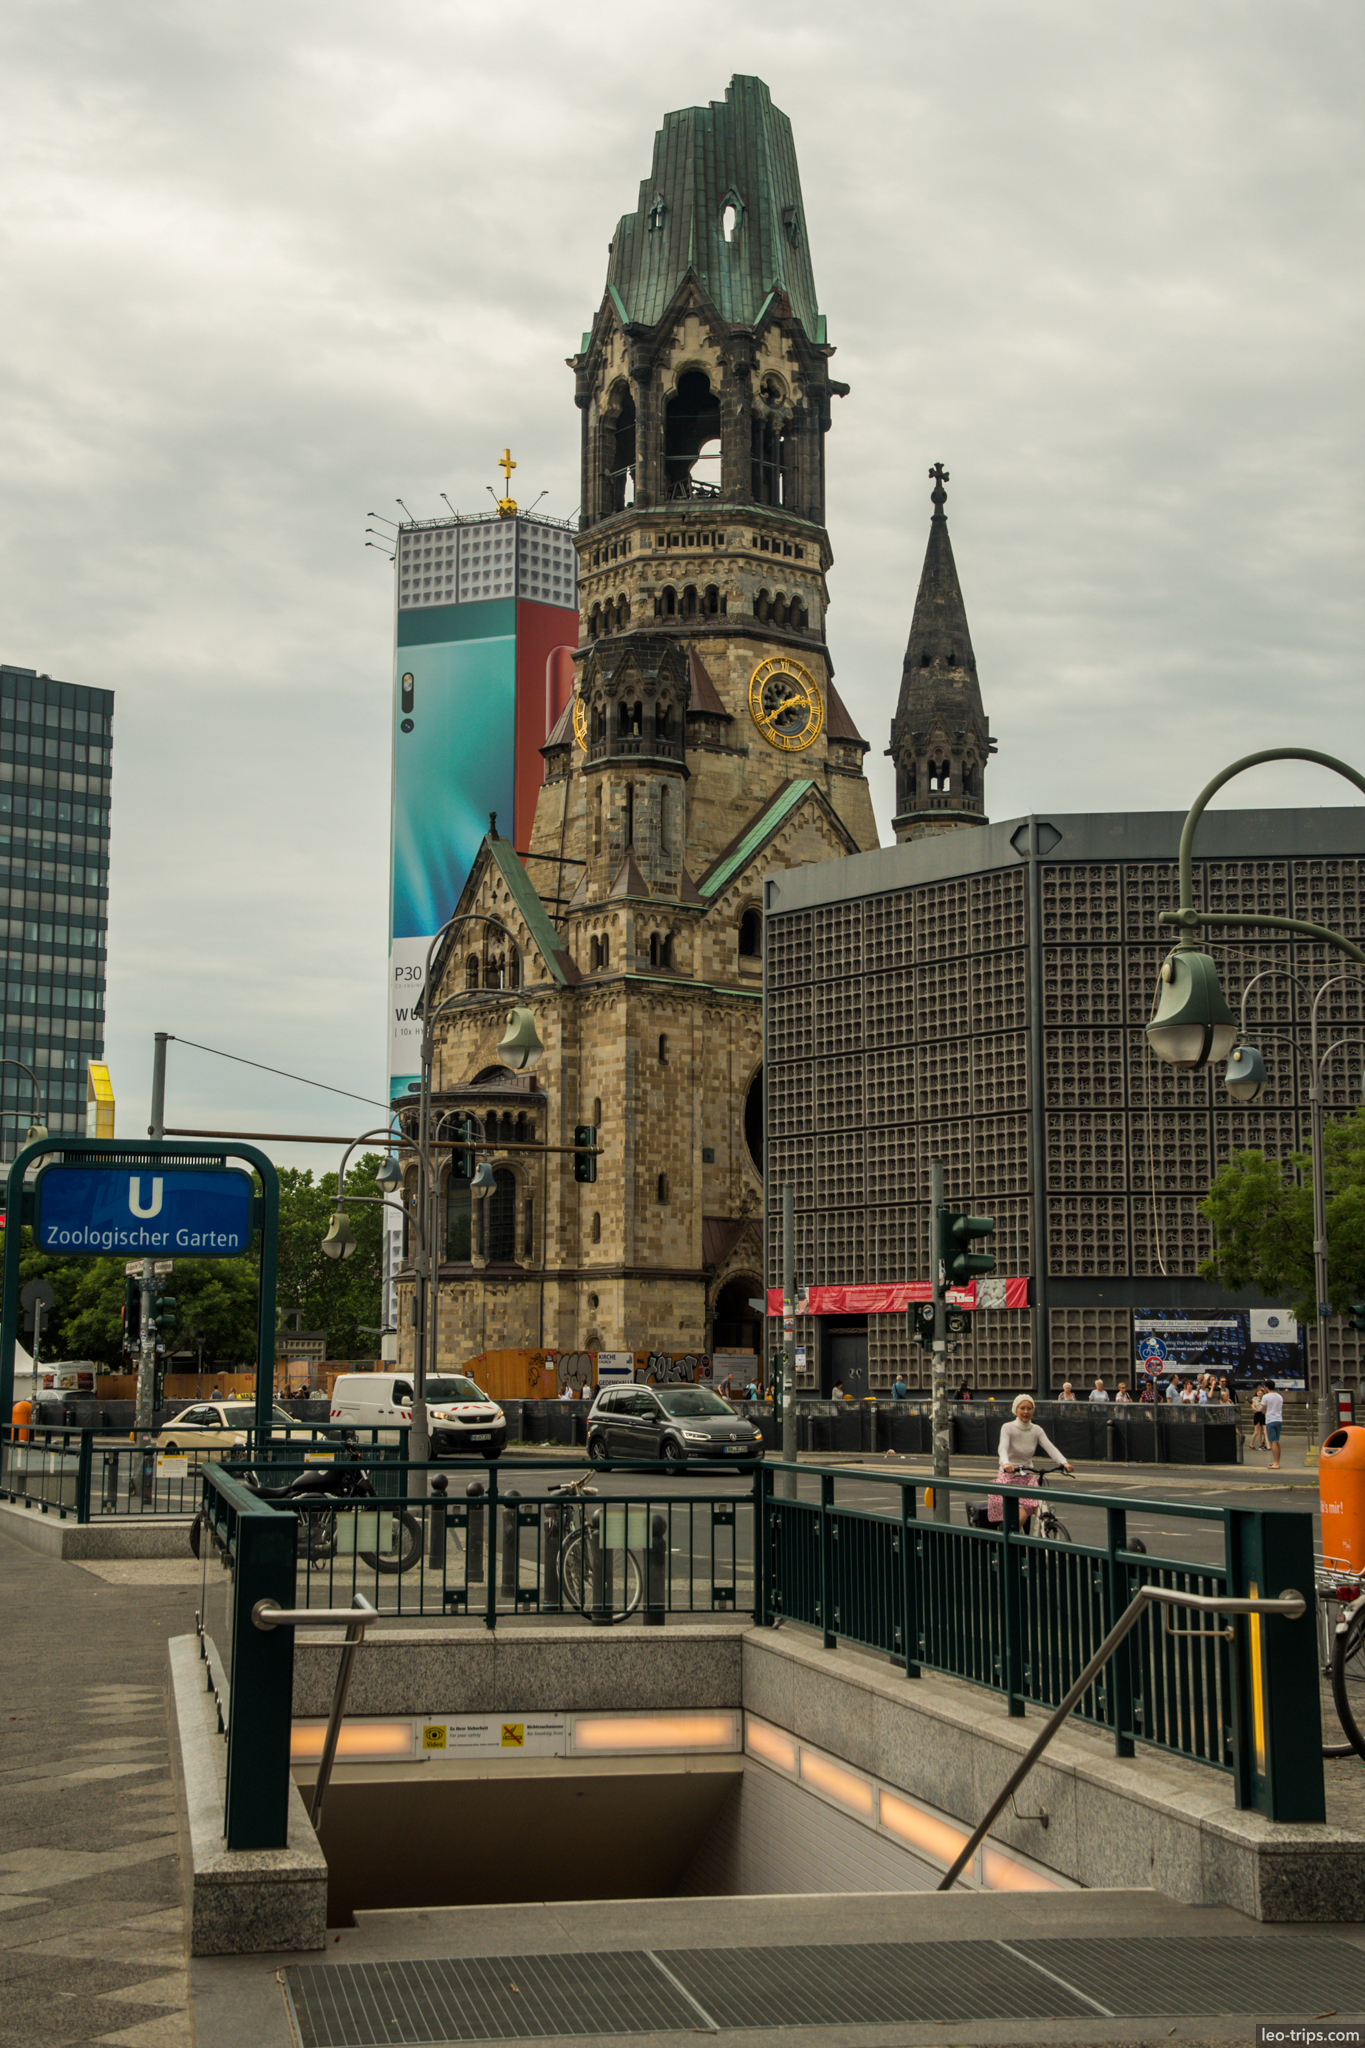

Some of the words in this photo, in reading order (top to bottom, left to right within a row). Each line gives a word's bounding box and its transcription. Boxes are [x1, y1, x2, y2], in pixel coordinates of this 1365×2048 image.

[395, 966, 422, 981] P30
[400, 1028, 412, 1036] 10x
[128, 1176, 164, 1219] U
[47, 1226, 170, 1250] Zoologischer
[176, 1228, 238, 1247] Garten
[1329, 1501, 1344, 1514] mir!
